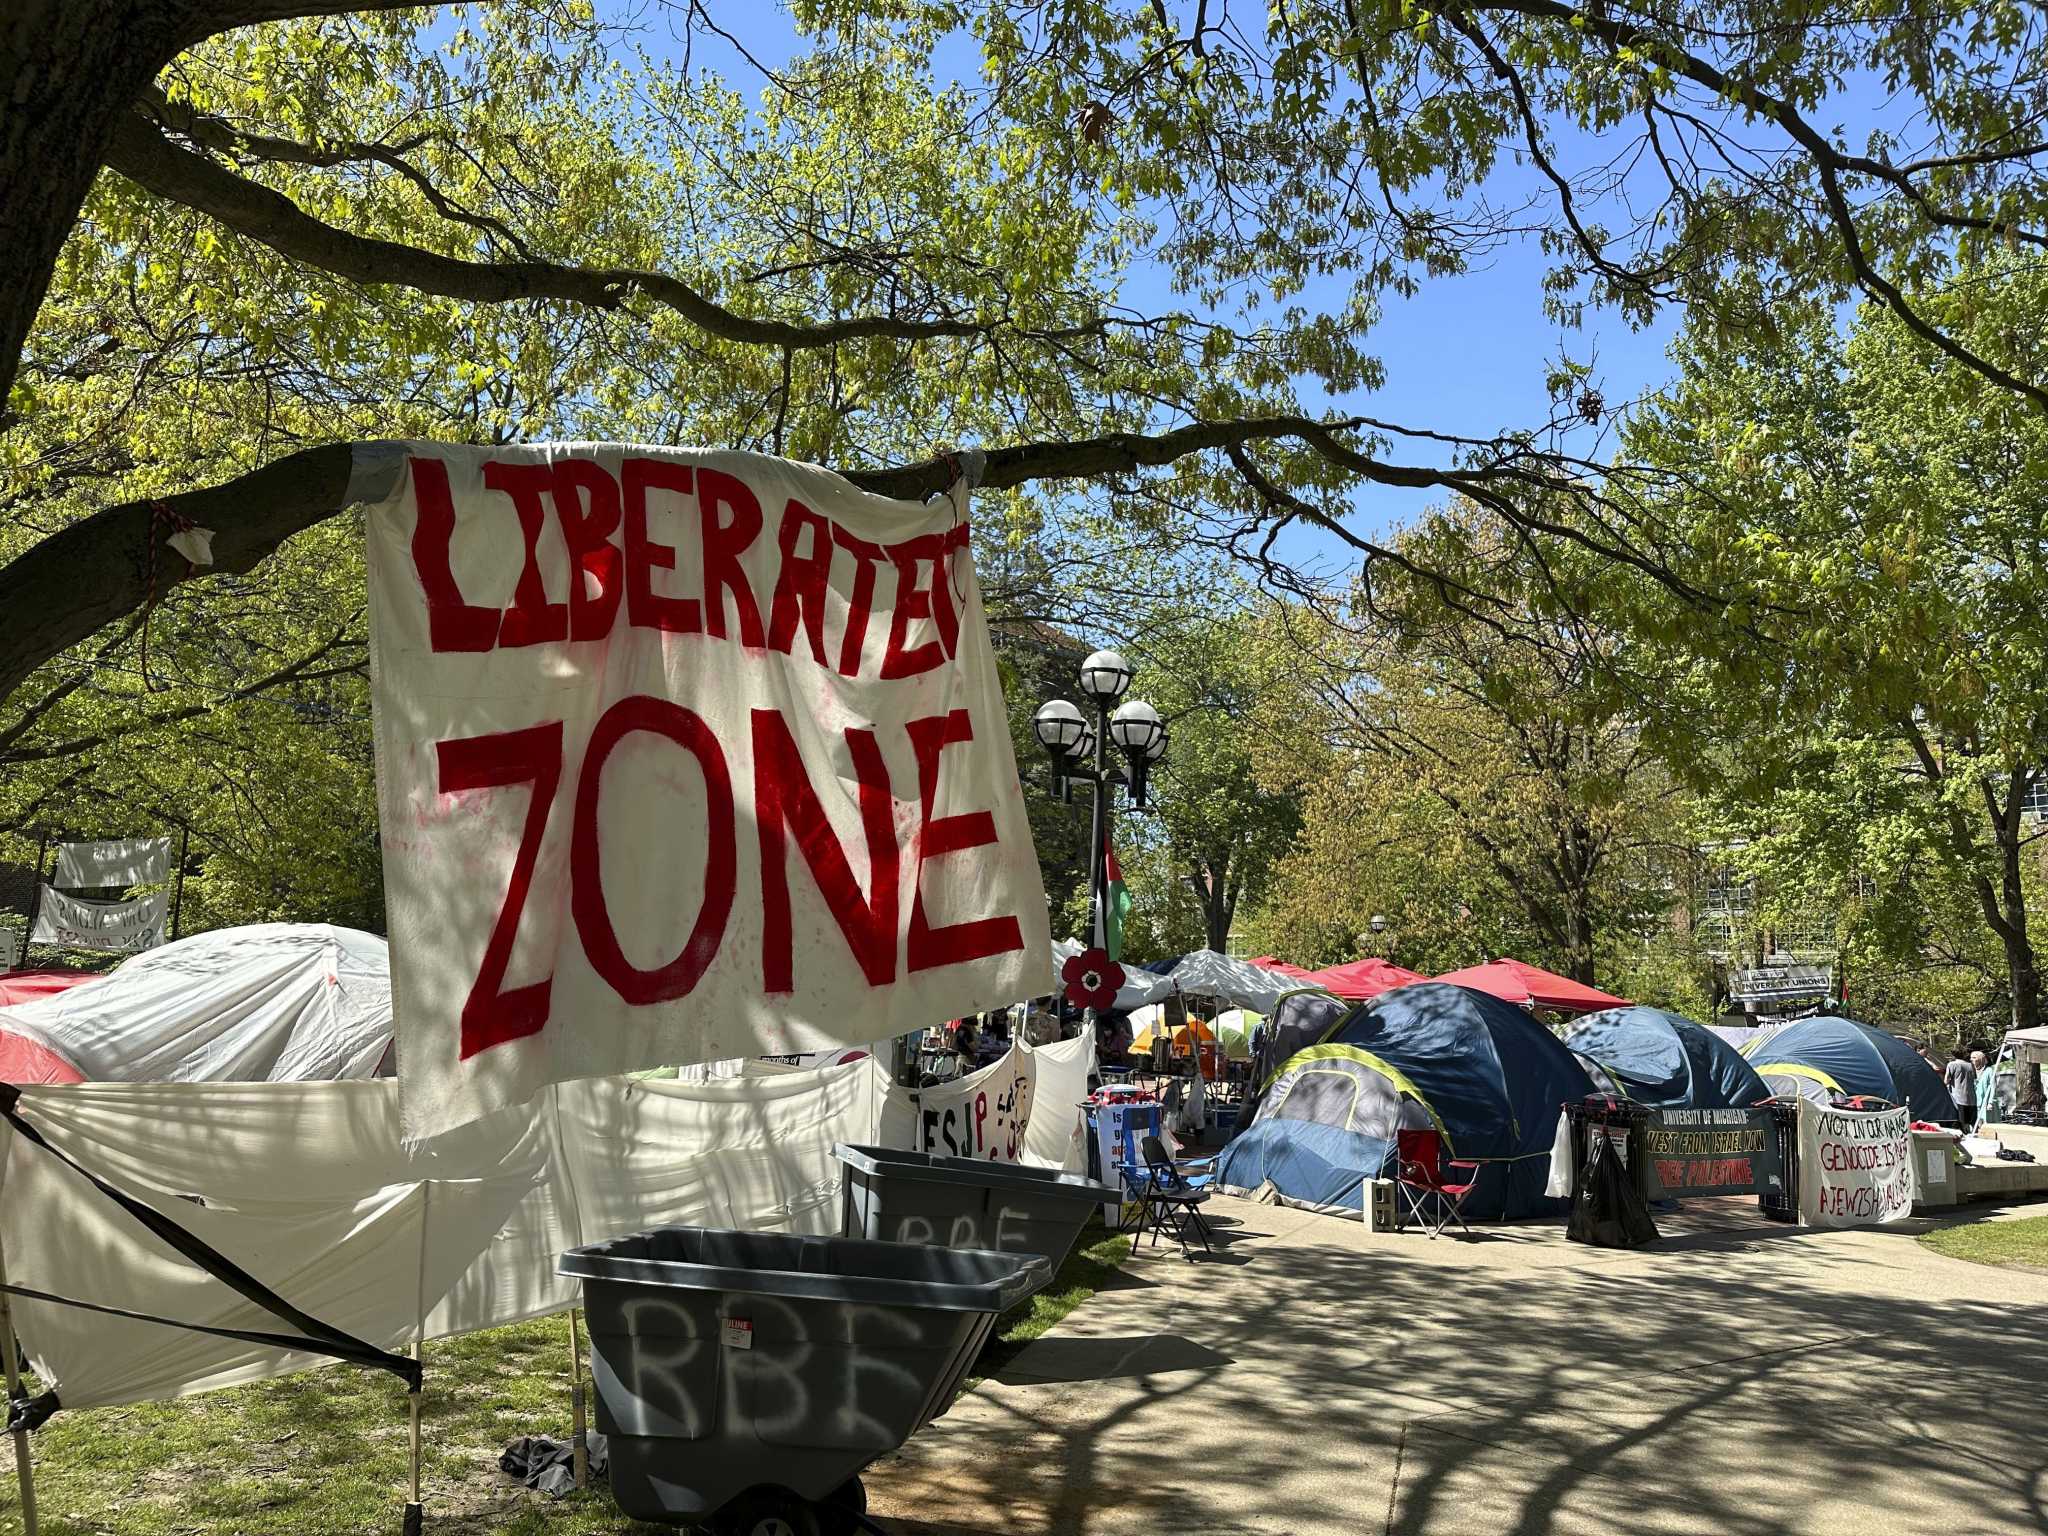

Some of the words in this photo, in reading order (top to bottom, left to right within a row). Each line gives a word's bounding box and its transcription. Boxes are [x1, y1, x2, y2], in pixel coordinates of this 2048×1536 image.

[435, 694, 1026, 1062] ZONE
[1741, 979, 1790, 992] NIVERSITY
[1792, 976, 1826, 987] UNIONS
[790, 1055, 799, 1066] of
[1662, 1109, 1701, 1126] UNIVERSITY
[1702, 1109, 1712, 1125] OF
[1818, 1111, 1849, 1136] NOT
[1850, 1118, 1866, 1140] IN
[1884, 1110, 1909, 1139] NAME
[1680, 1131, 1710, 1154] FROM
[1711, 1130, 1742, 1154] ISRAEL
[1743, 1129, 1767, 1152] NOW
[1820, 1142, 1882, 1172] GENOCIDE
[1882, 1142, 1895, 1168] IS
[1686, 1158, 1754, 1187] PALESTINE
[1820, 1184, 1828, 1214] A
[1828, 1186, 1880, 1218] JEWISH
